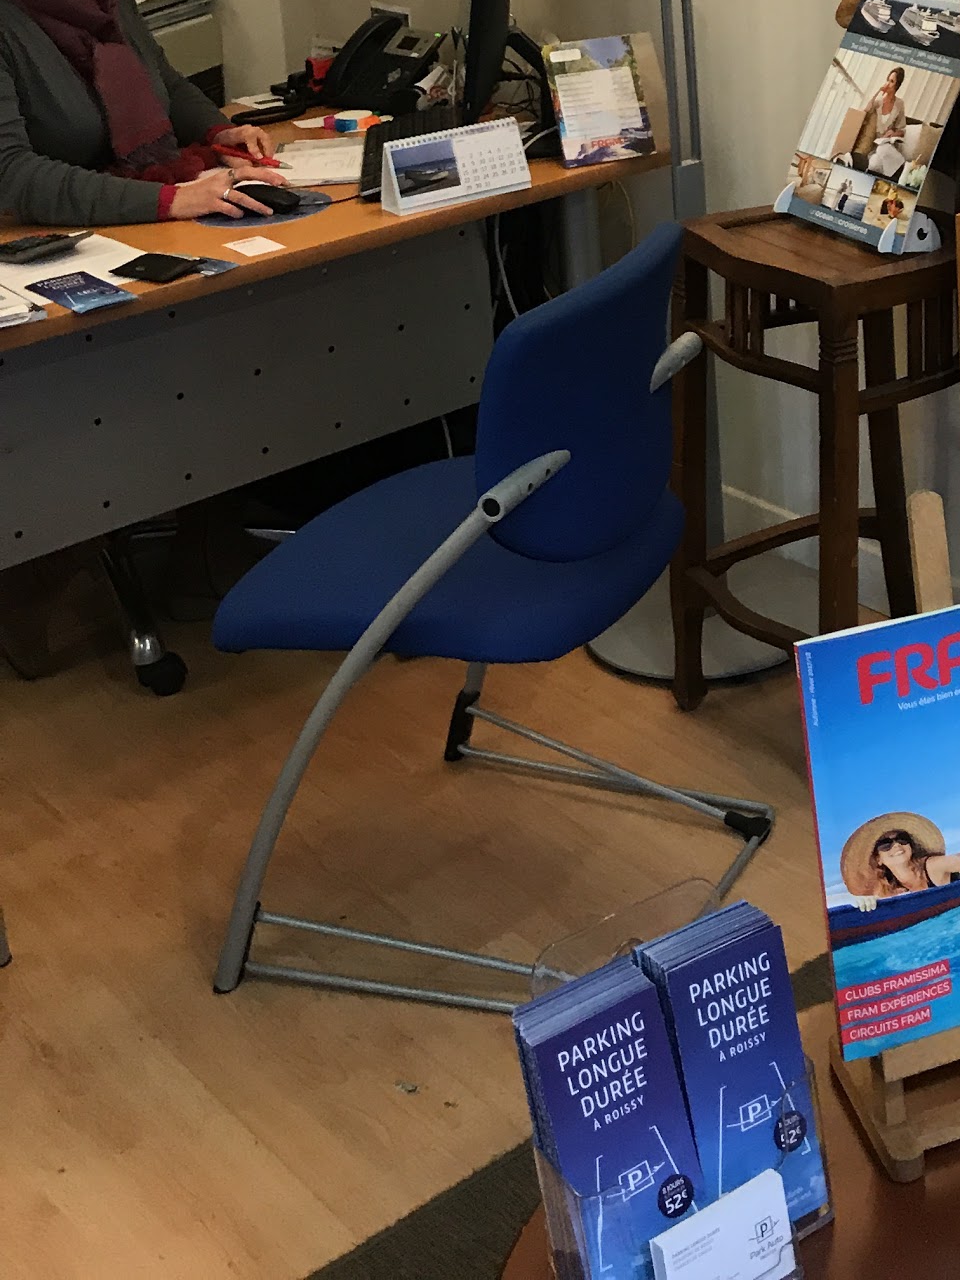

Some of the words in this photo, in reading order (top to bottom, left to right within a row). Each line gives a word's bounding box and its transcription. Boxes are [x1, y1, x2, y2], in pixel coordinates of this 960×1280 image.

[897, 700, 918, 711] Vous
[918, 694, 935, 707] êtes
[936, 689, 954, 703] bien
[688, 951, 771, 1004] PARKING
[845, 987, 882, 1002] CLUBS
[883, 964, 948, 992] FRAMISSIMA
[697, 977, 772, 1027] LONGUE
[847, 1005, 878, 1021] FRAM
[557, 1011, 645, 1072] PARKING
[708, 1005, 770, 1049] DURÉE
[850, 1019, 899, 1040] CIRCUITS
[900, 1008, 931, 1027] FRAM
[719, 1049, 727, 1062] À
[729, 1032, 767, 1059] ROISSY
[567, 1037, 648, 1096] LONGUE
[580, 1066, 648, 1118] DURÉE
[593, 1117, 603, 1131] À
[605, 1094, 645, 1126] ROISSY
[749, 1246, 766, 1260] Park
[767, 1235, 784, 1250] Auto
